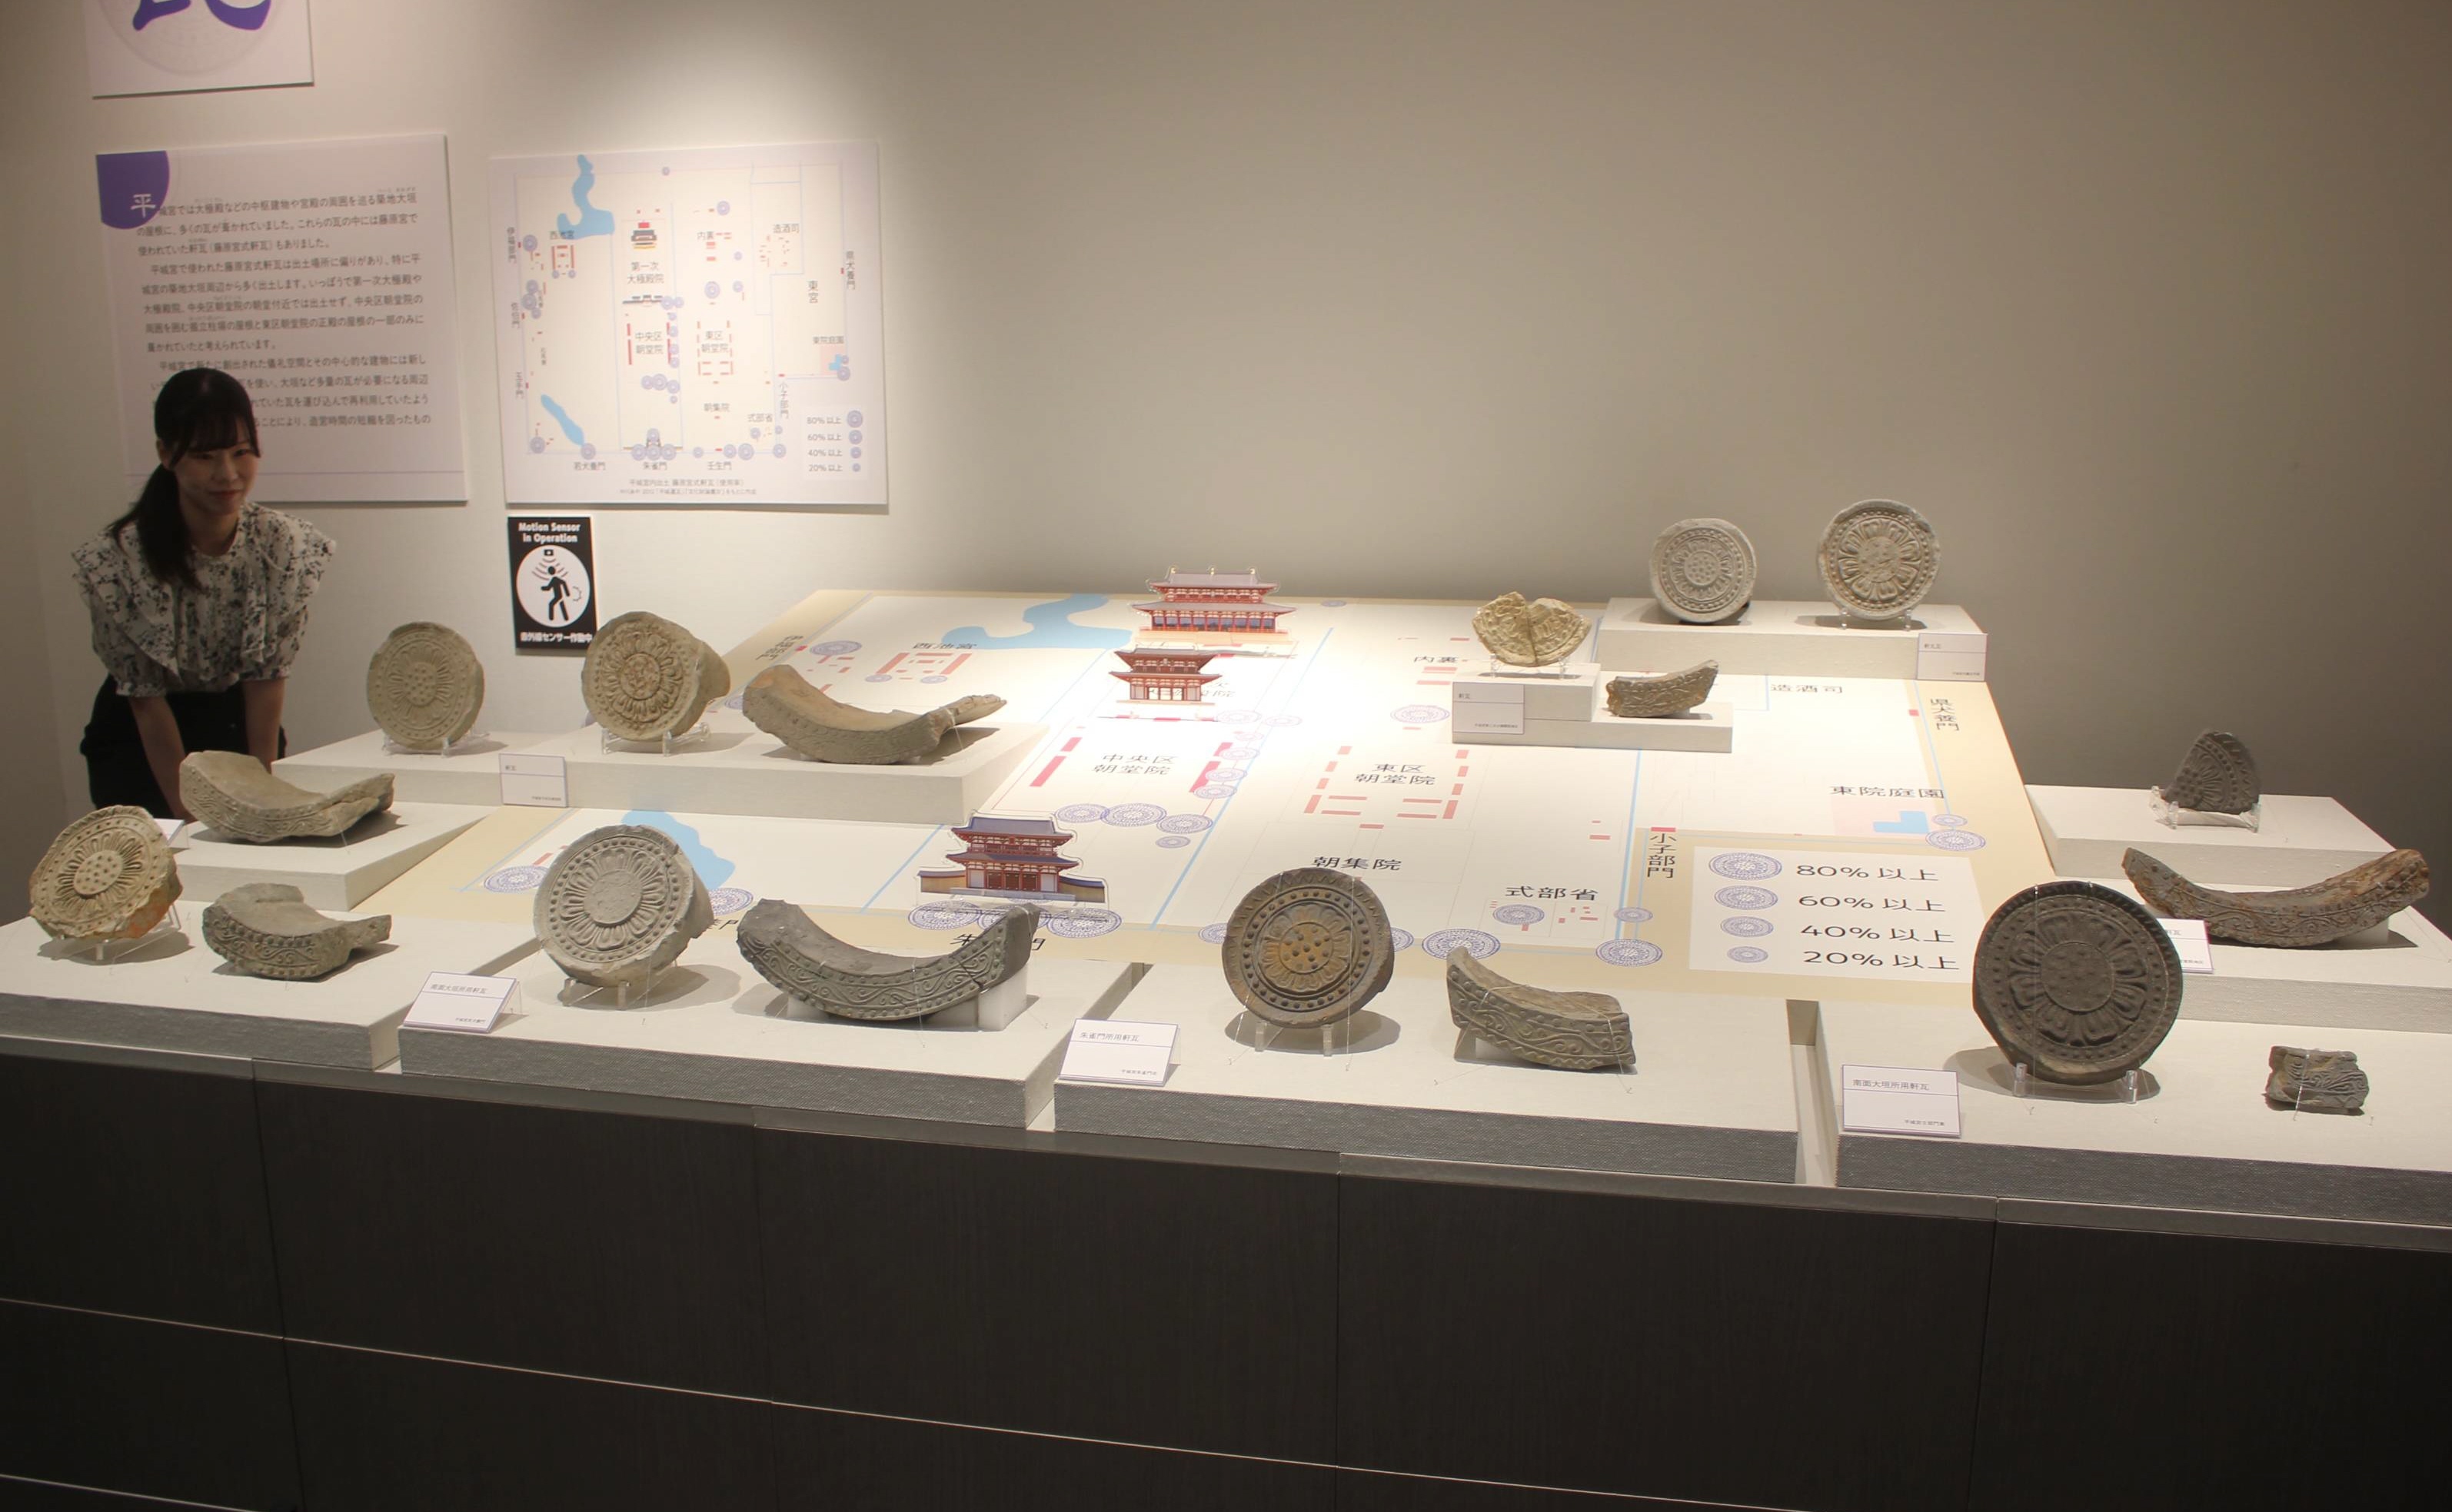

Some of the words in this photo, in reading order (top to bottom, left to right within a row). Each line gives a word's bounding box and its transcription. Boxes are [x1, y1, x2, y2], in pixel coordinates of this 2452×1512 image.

[630, 261, 659, 271] 第一次
[627, 274, 665, 284] 大極殿院
[808, 280, 819, 304] 東宮
[635, 331, 663, 341] 中央区
[636, 344, 664, 354] 朝堂院
[701, 343, 729, 353] 朝堂院
[518, 522, 549, 531] Motion
[551, 522, 581, 531] Sensor
[533, 533, 577, 543] Operation
[521, 632, 592, 643] 赤外線センサー作動中
[1771, 683, 1843, 693] 造酒司
[1102, 753, 1179, 764] 中央区
[1091, 764, 1171, 775] 朝堂院
[1373, 763, 1426, 773] 東区
[1353, 773, 1436, 786] 朝堂院
[1828, 785, 1945, 799] 東院庭園
[1647, 832, 1677, 879] 小子部門
[1310, 856, 1402, 871] 朝集院
[1505, 886, 1599, 901] 式部省
[1080, 1032, 1139, 1042] 朱雀門所用軒瓦
[1852, 1078, 1930, 1091] 南面大垣所用軒瓦
